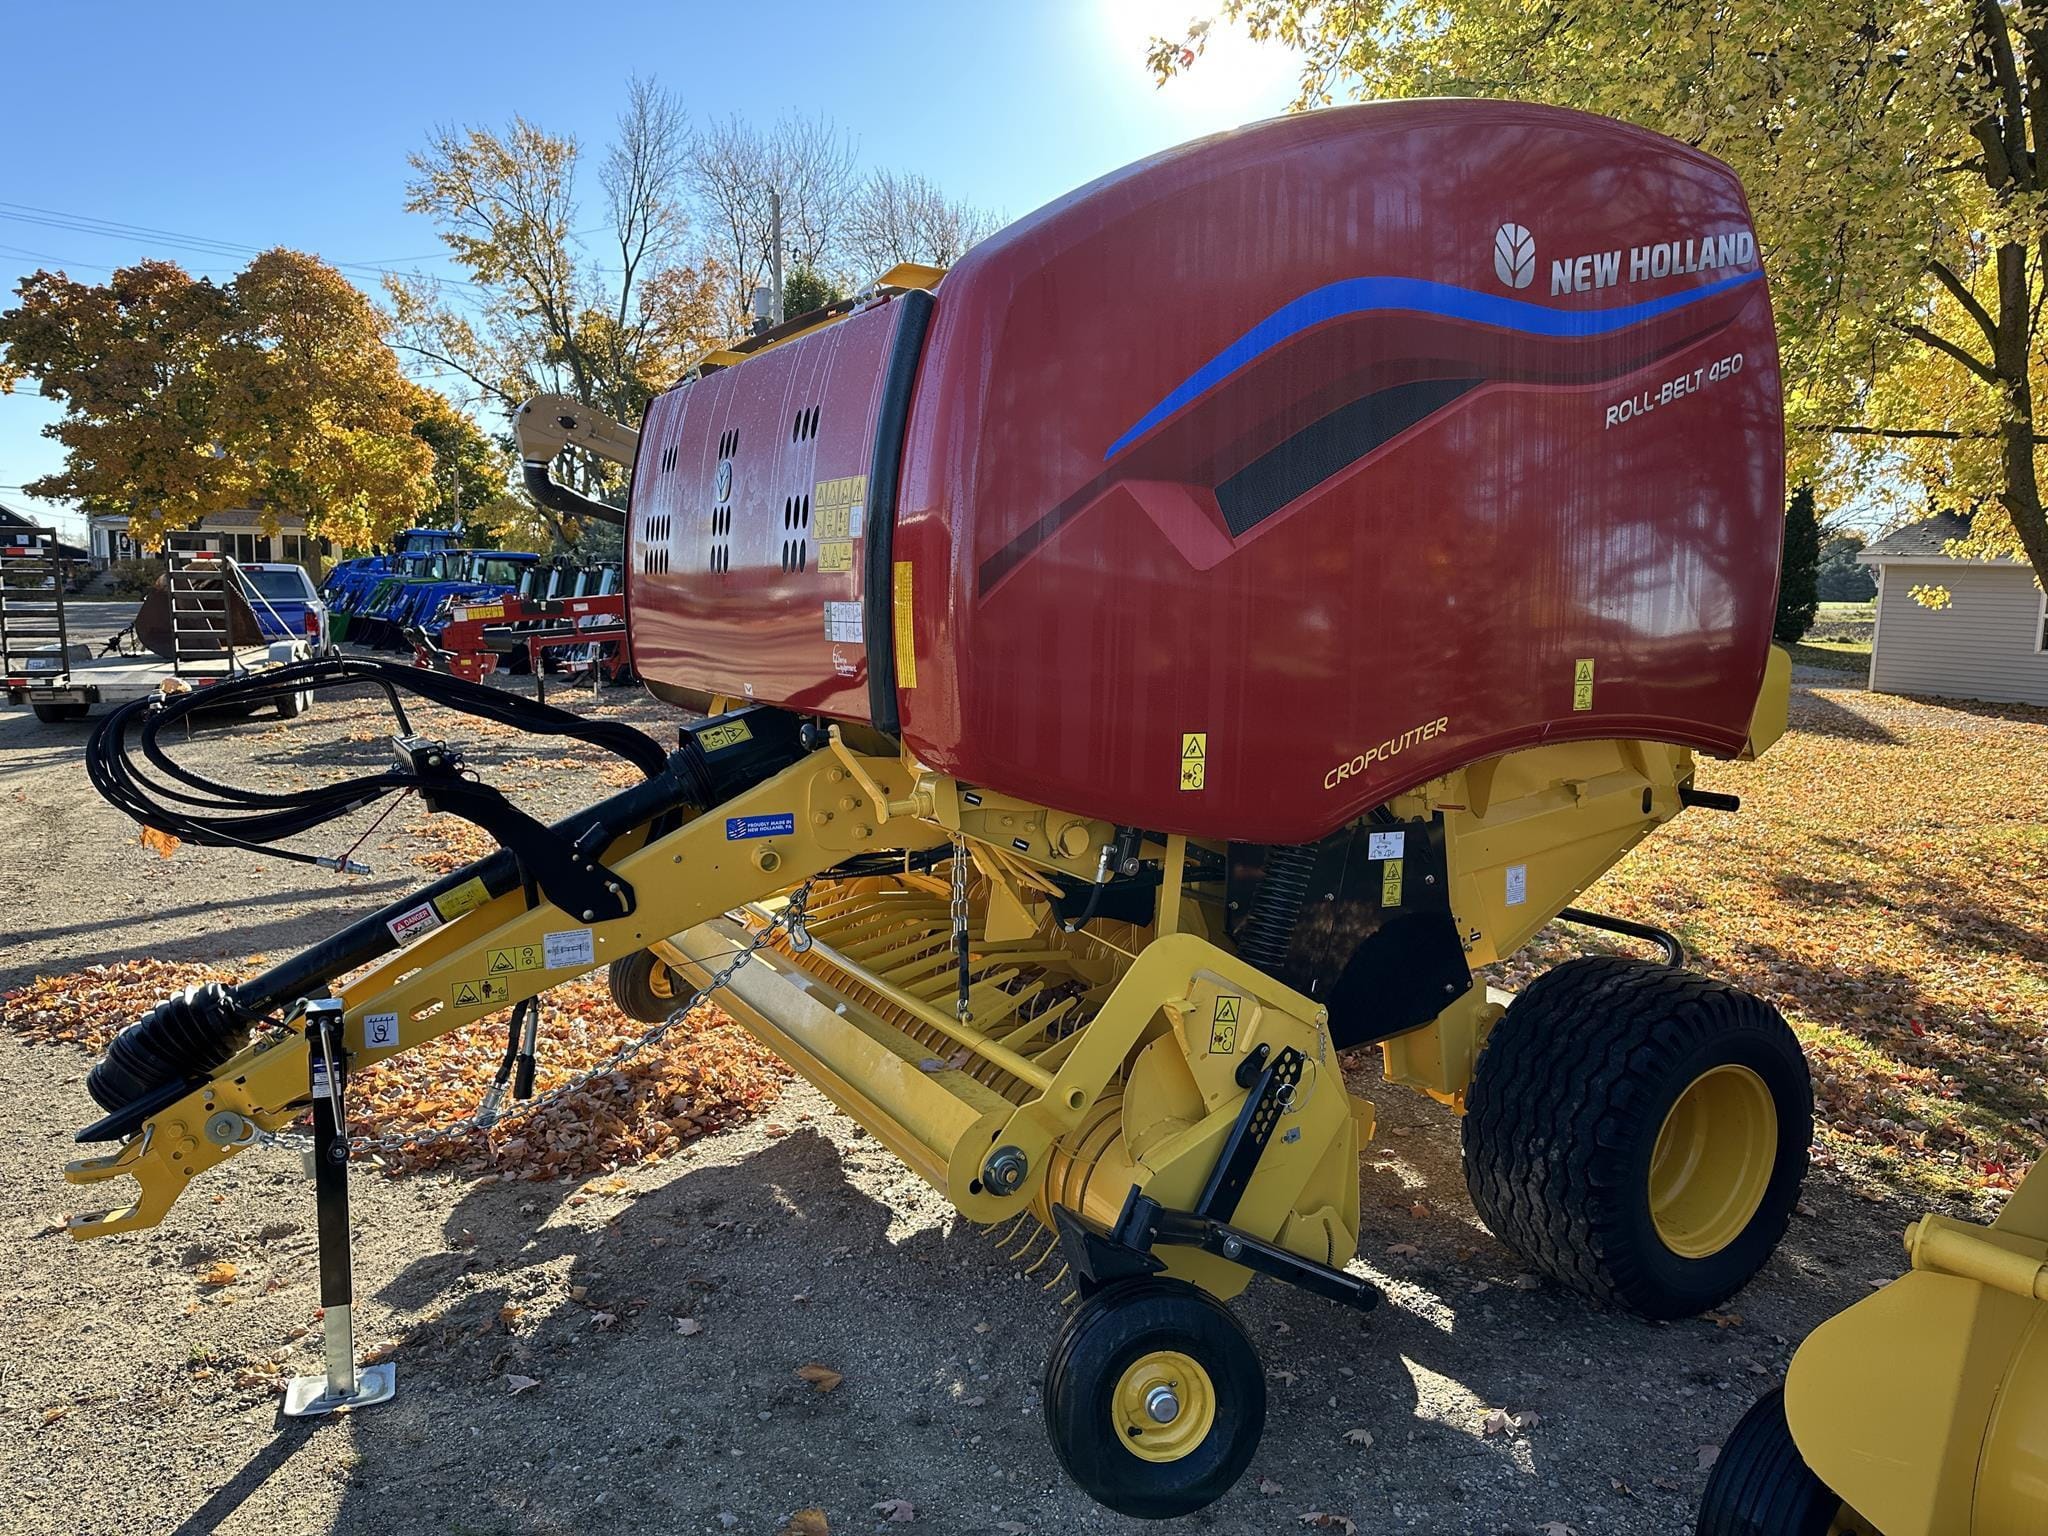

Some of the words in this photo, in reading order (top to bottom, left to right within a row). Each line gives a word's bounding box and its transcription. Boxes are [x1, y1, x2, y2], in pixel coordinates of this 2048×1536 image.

[1551, 250, 1621, 297] NEW
[1629, 231, 1754, 283] HOLLAND
[1605, 368, 1704, 430] ROLL-BELT
[1708, 353, 1743, 382] 450
[1324, 716, 1449, 790] CROPCUTTER
[403, 910, 429, 926] DANGER
